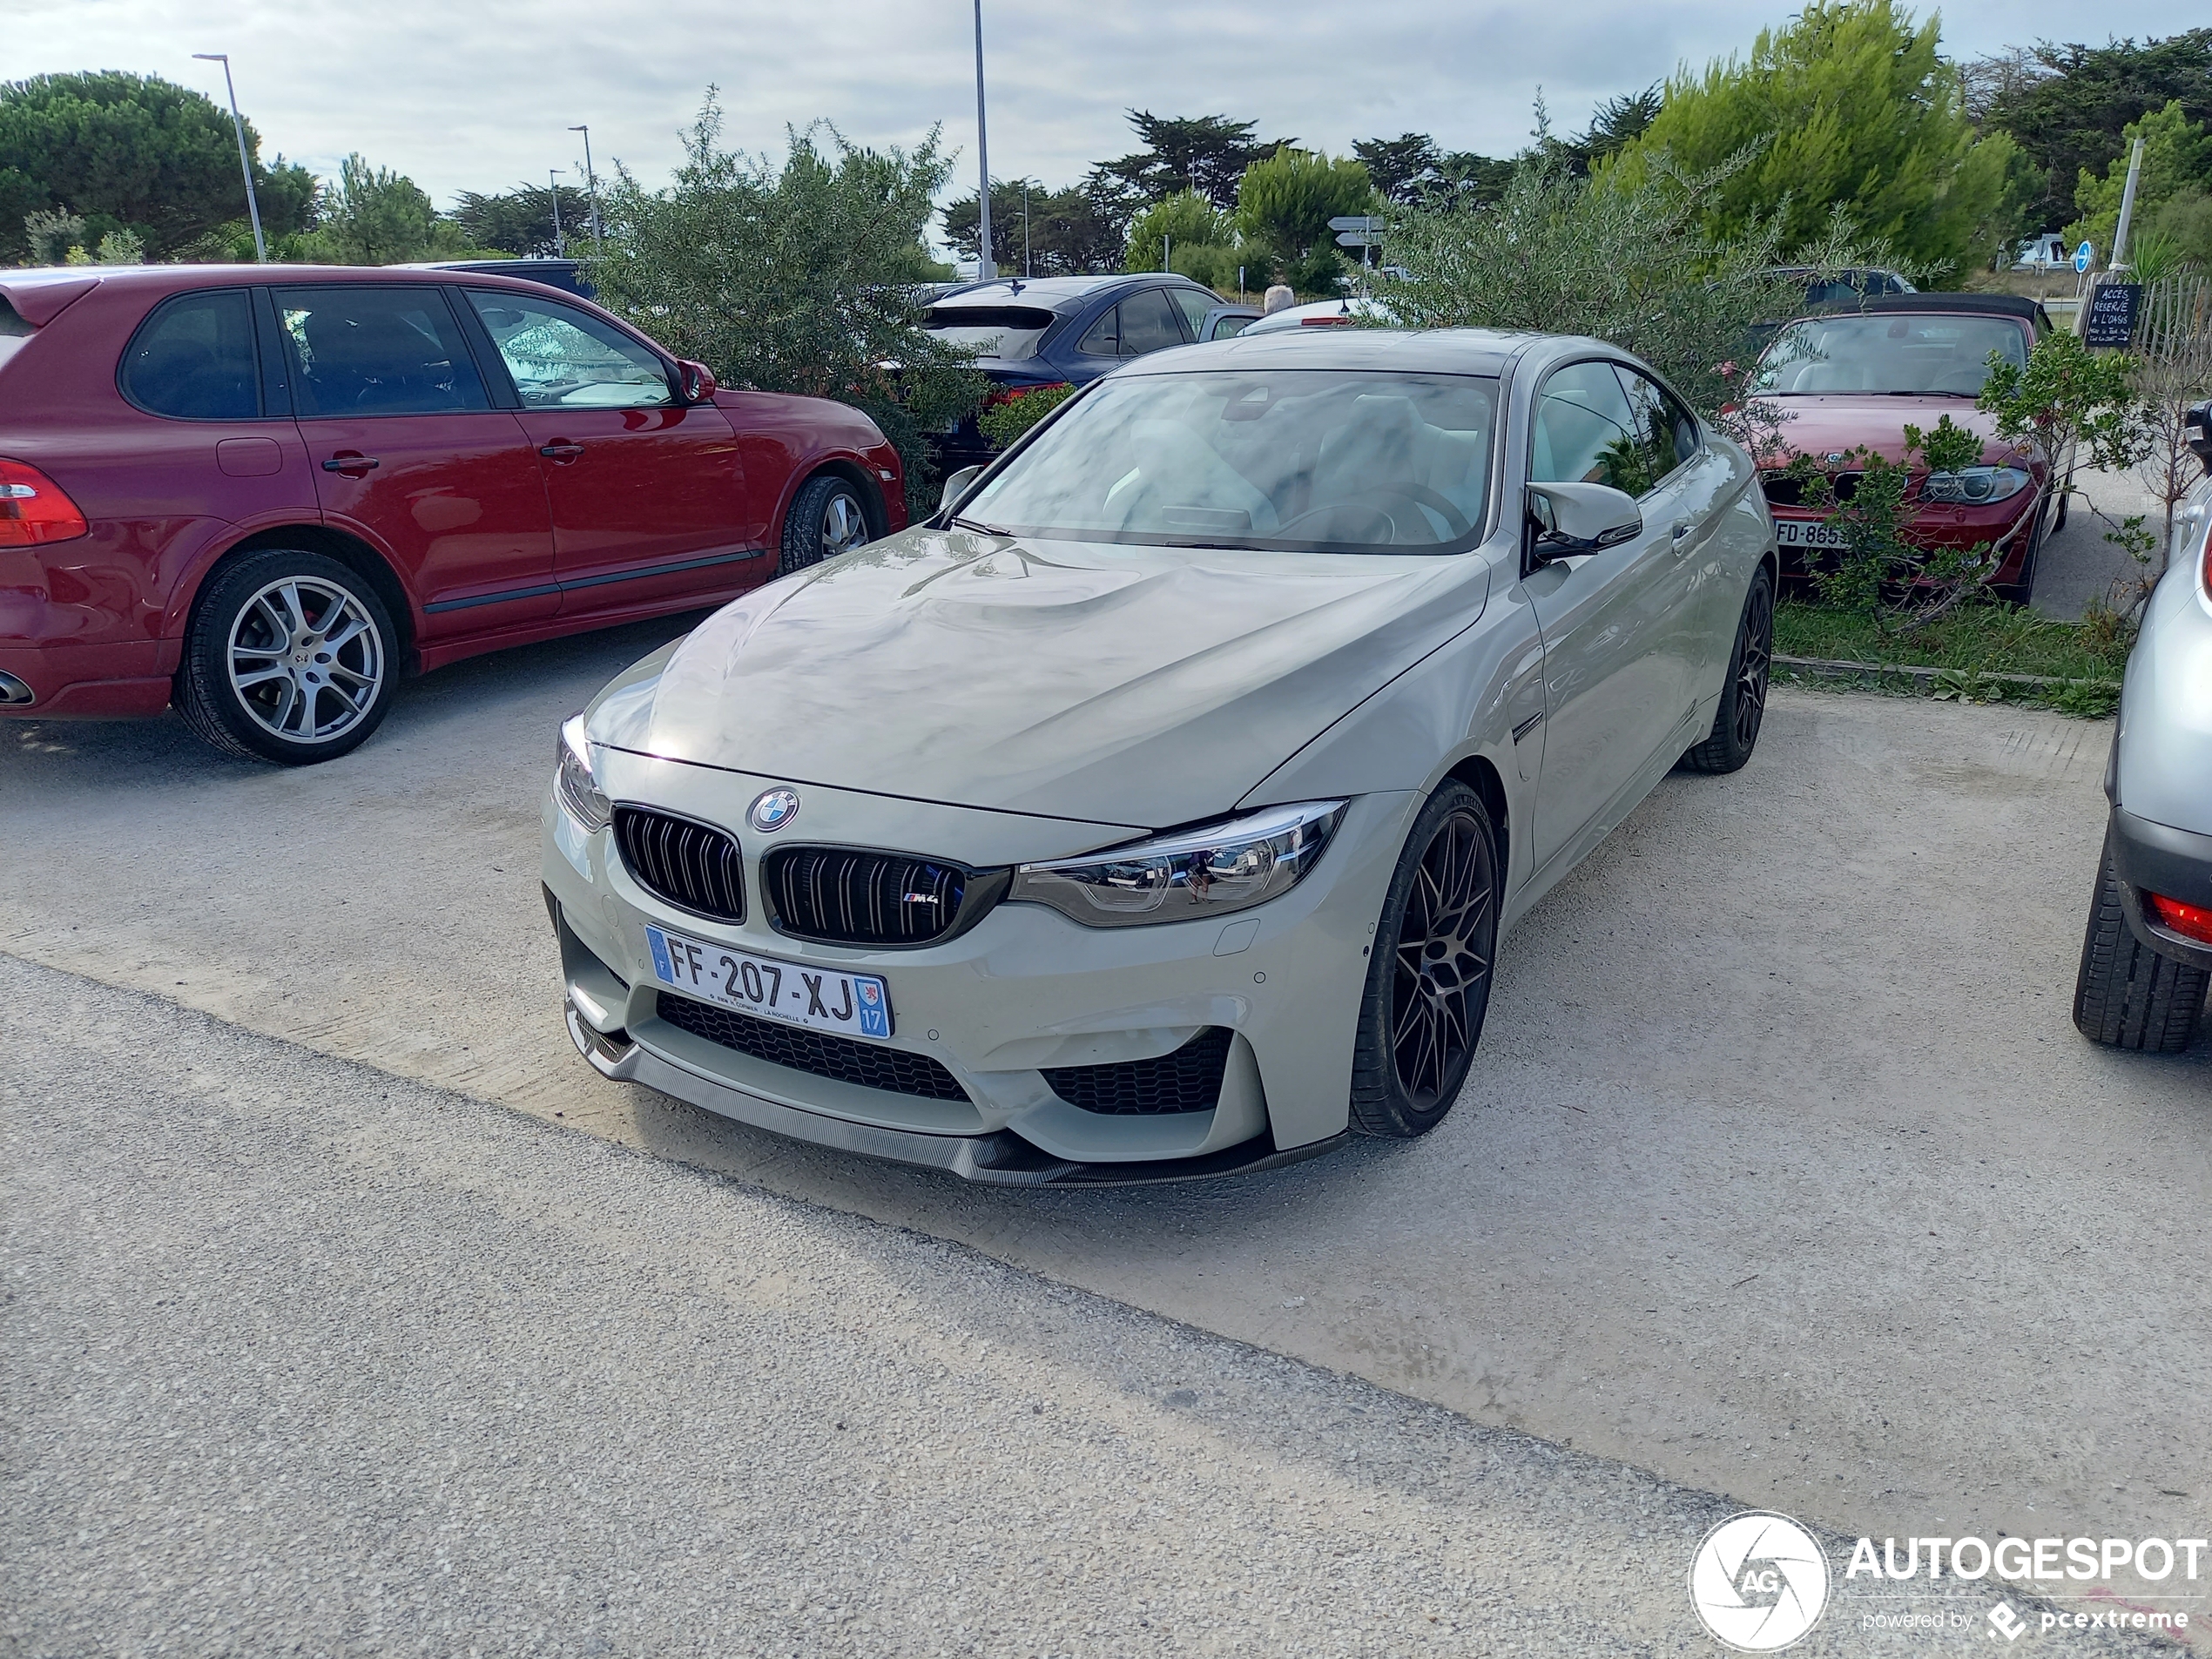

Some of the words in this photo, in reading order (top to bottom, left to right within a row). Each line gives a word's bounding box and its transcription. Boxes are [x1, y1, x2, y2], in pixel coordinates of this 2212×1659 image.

[912, 894, 938, 904] M4
[659, 960, 665, 971] F
[667, 938, 853, 1021] FF-207-XJ
[862, 1009, 881, 1029] 17
